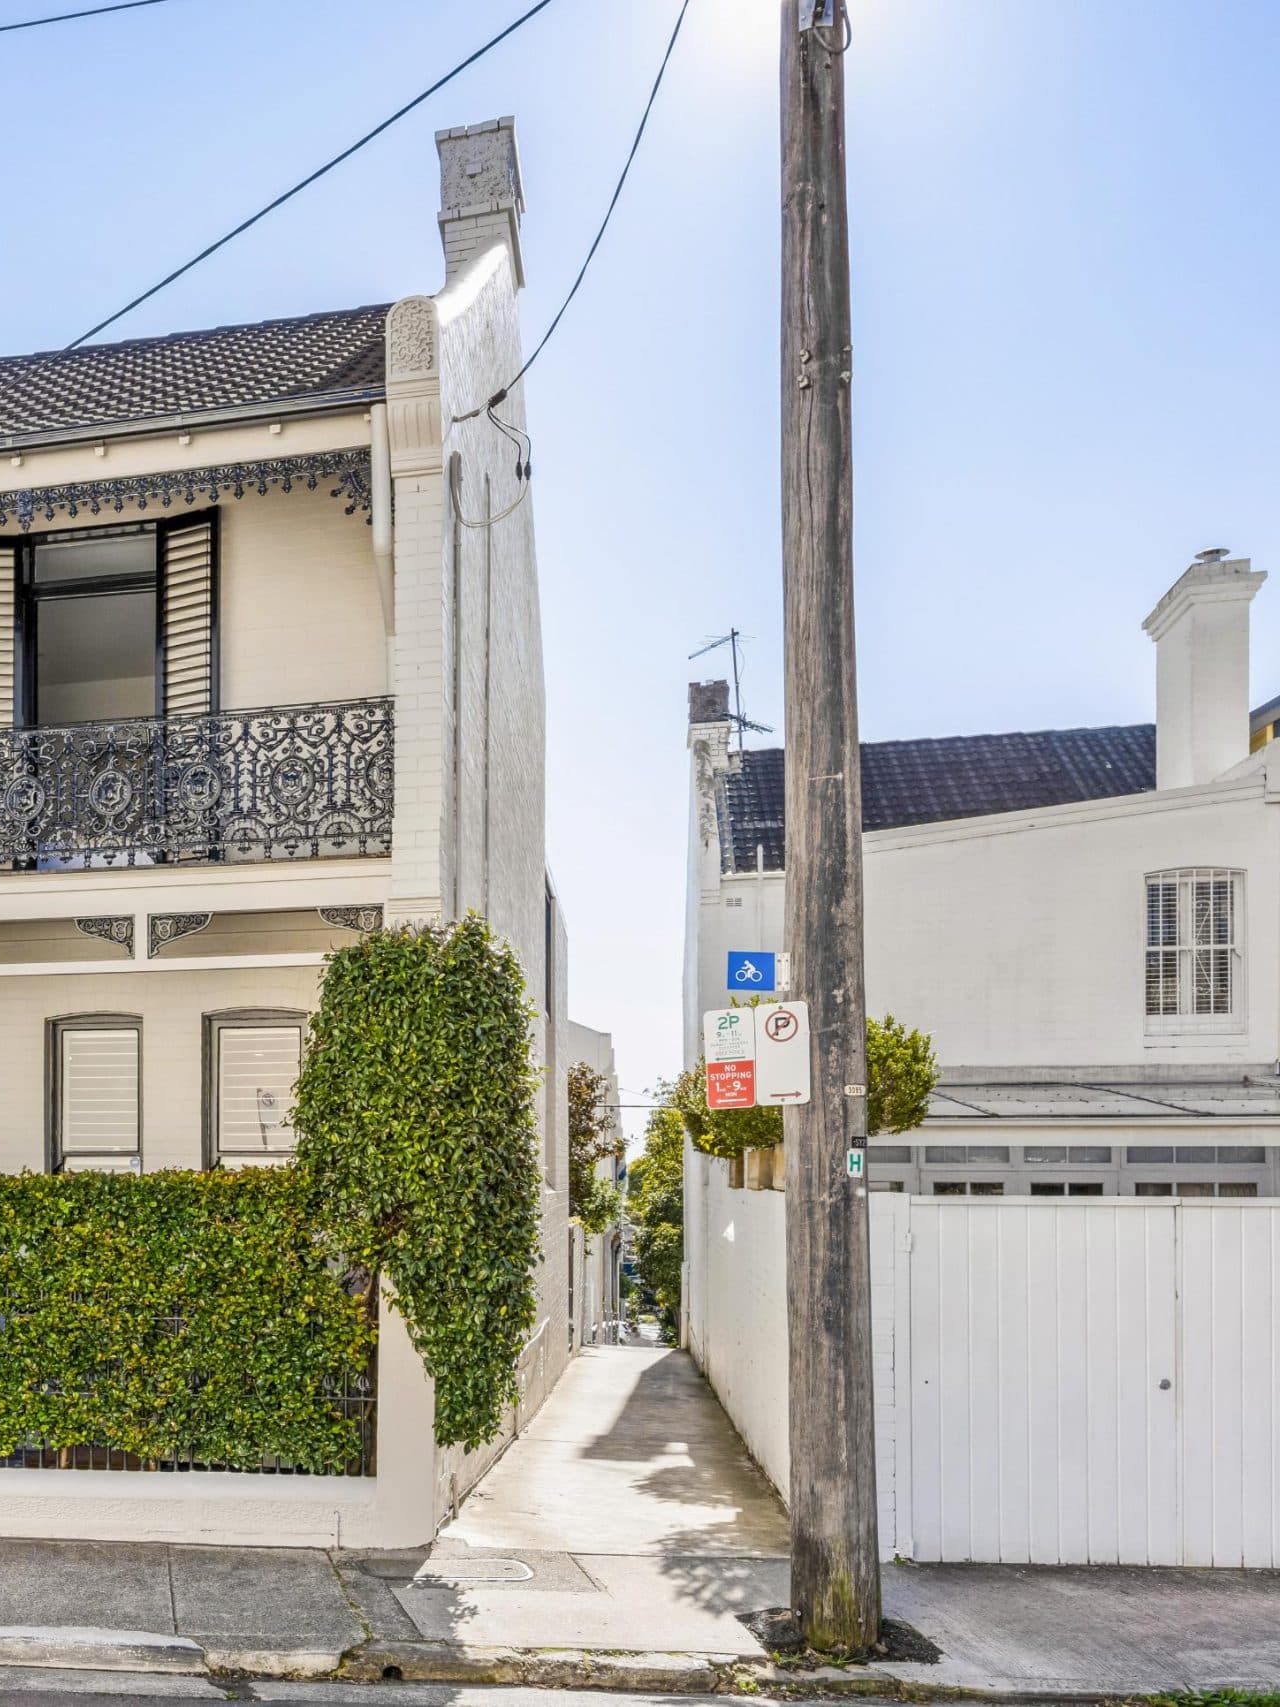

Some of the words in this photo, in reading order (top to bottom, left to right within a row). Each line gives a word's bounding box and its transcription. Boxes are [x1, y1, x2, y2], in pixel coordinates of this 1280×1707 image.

[717, 1015, 740, 1030] 2P
[724, 1064, 737, 1072] NO
[710, 1071, 752, 1081] STOPPING
[849, 1153, 861, 1172] H
